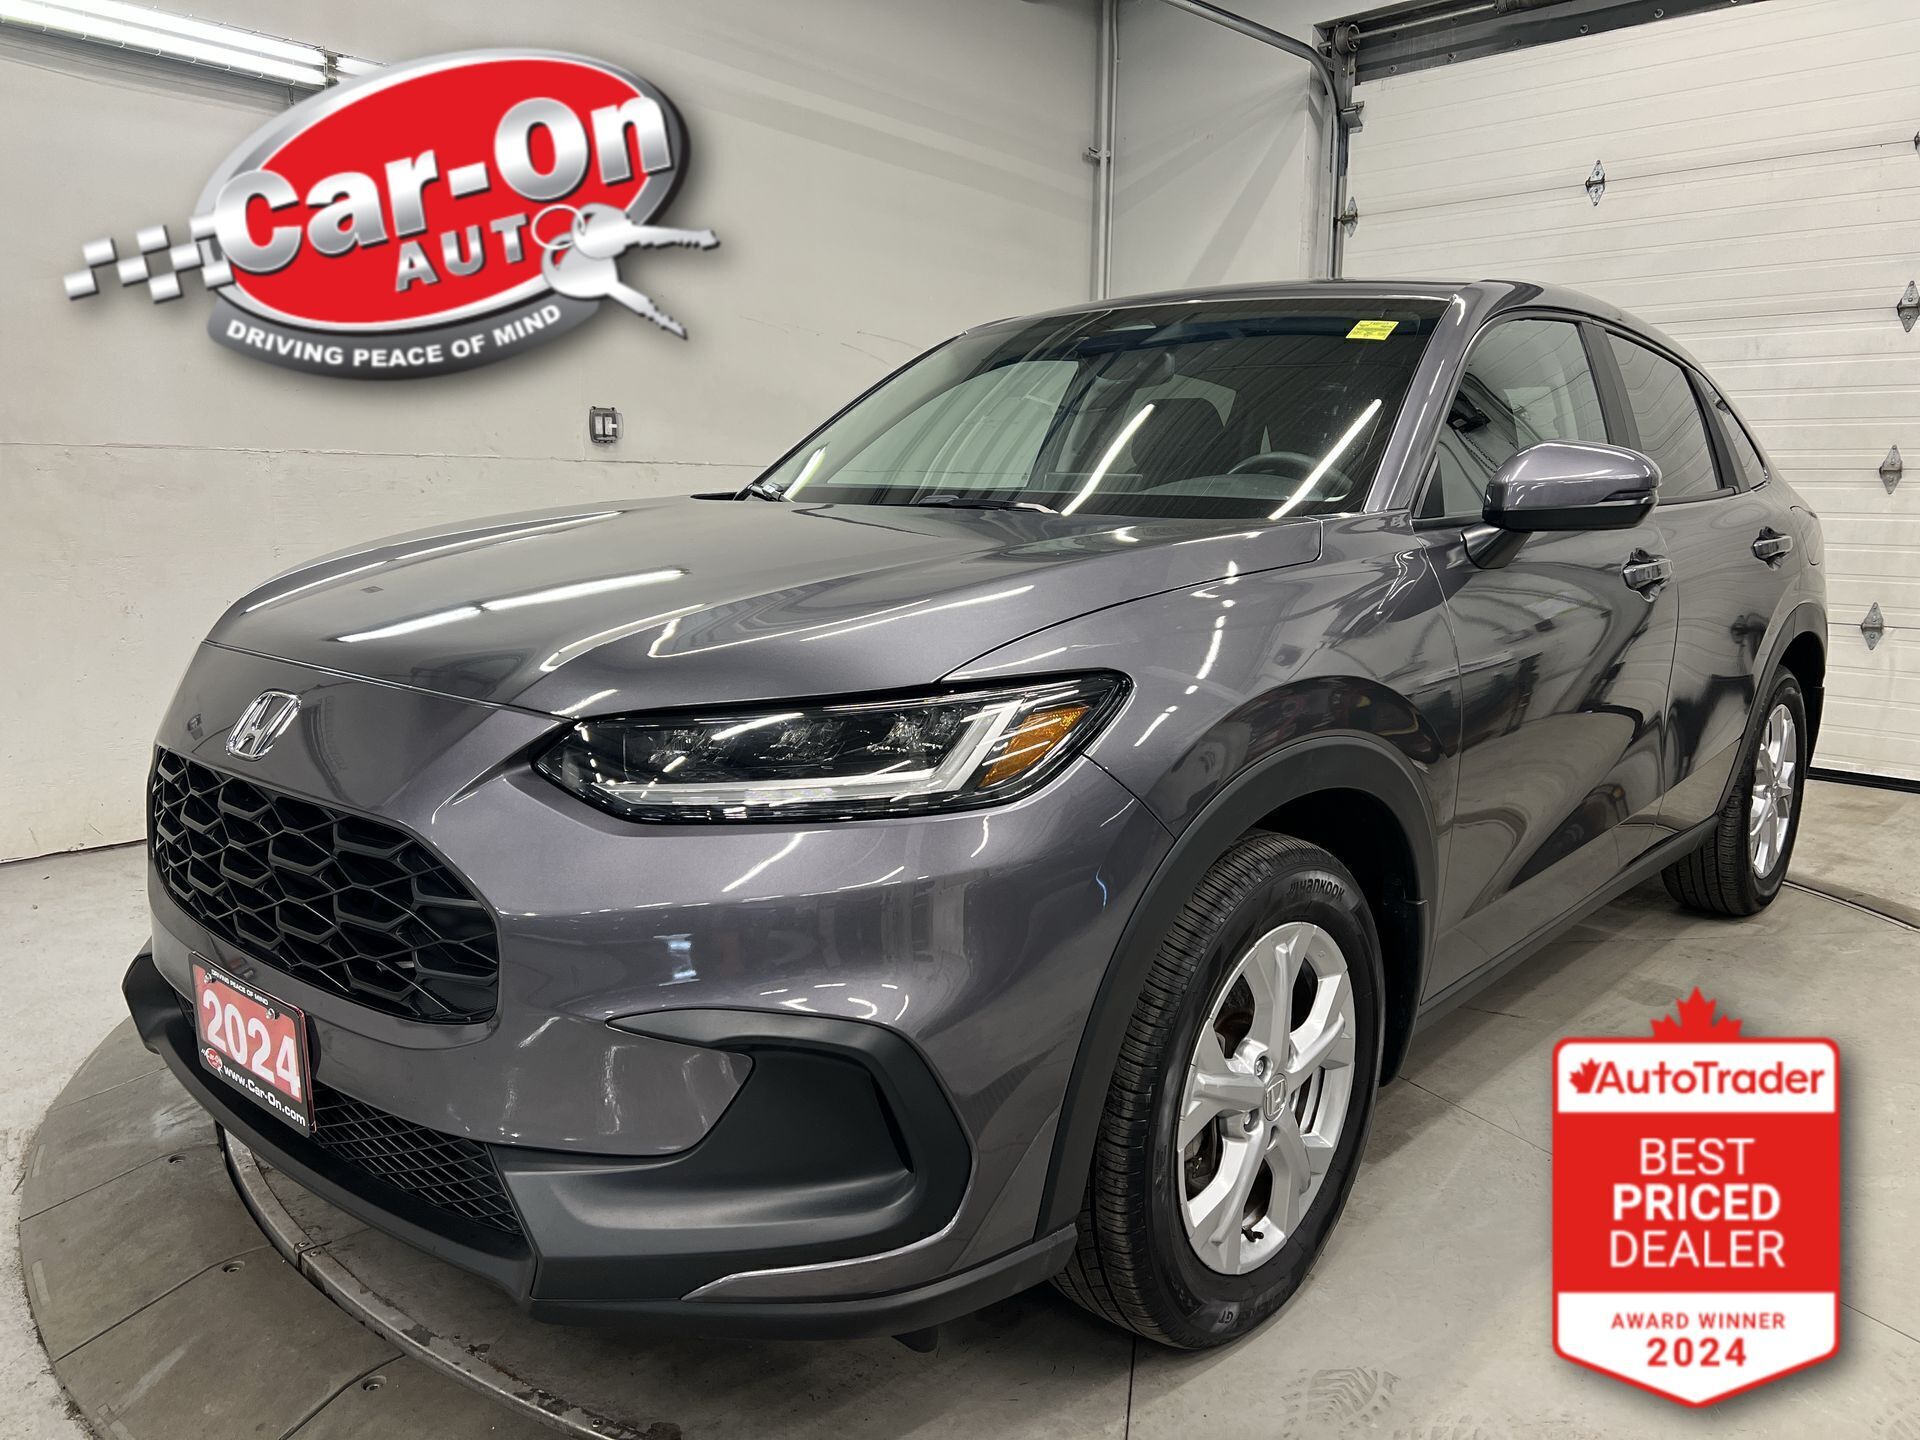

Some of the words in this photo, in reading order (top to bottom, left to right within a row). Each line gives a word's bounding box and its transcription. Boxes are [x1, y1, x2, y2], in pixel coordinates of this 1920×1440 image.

[246, 989, 254, 997] OF
[202, 989, 301, 1099] 2024
[223, 1064, 306, 1127] www.Car-On.com
